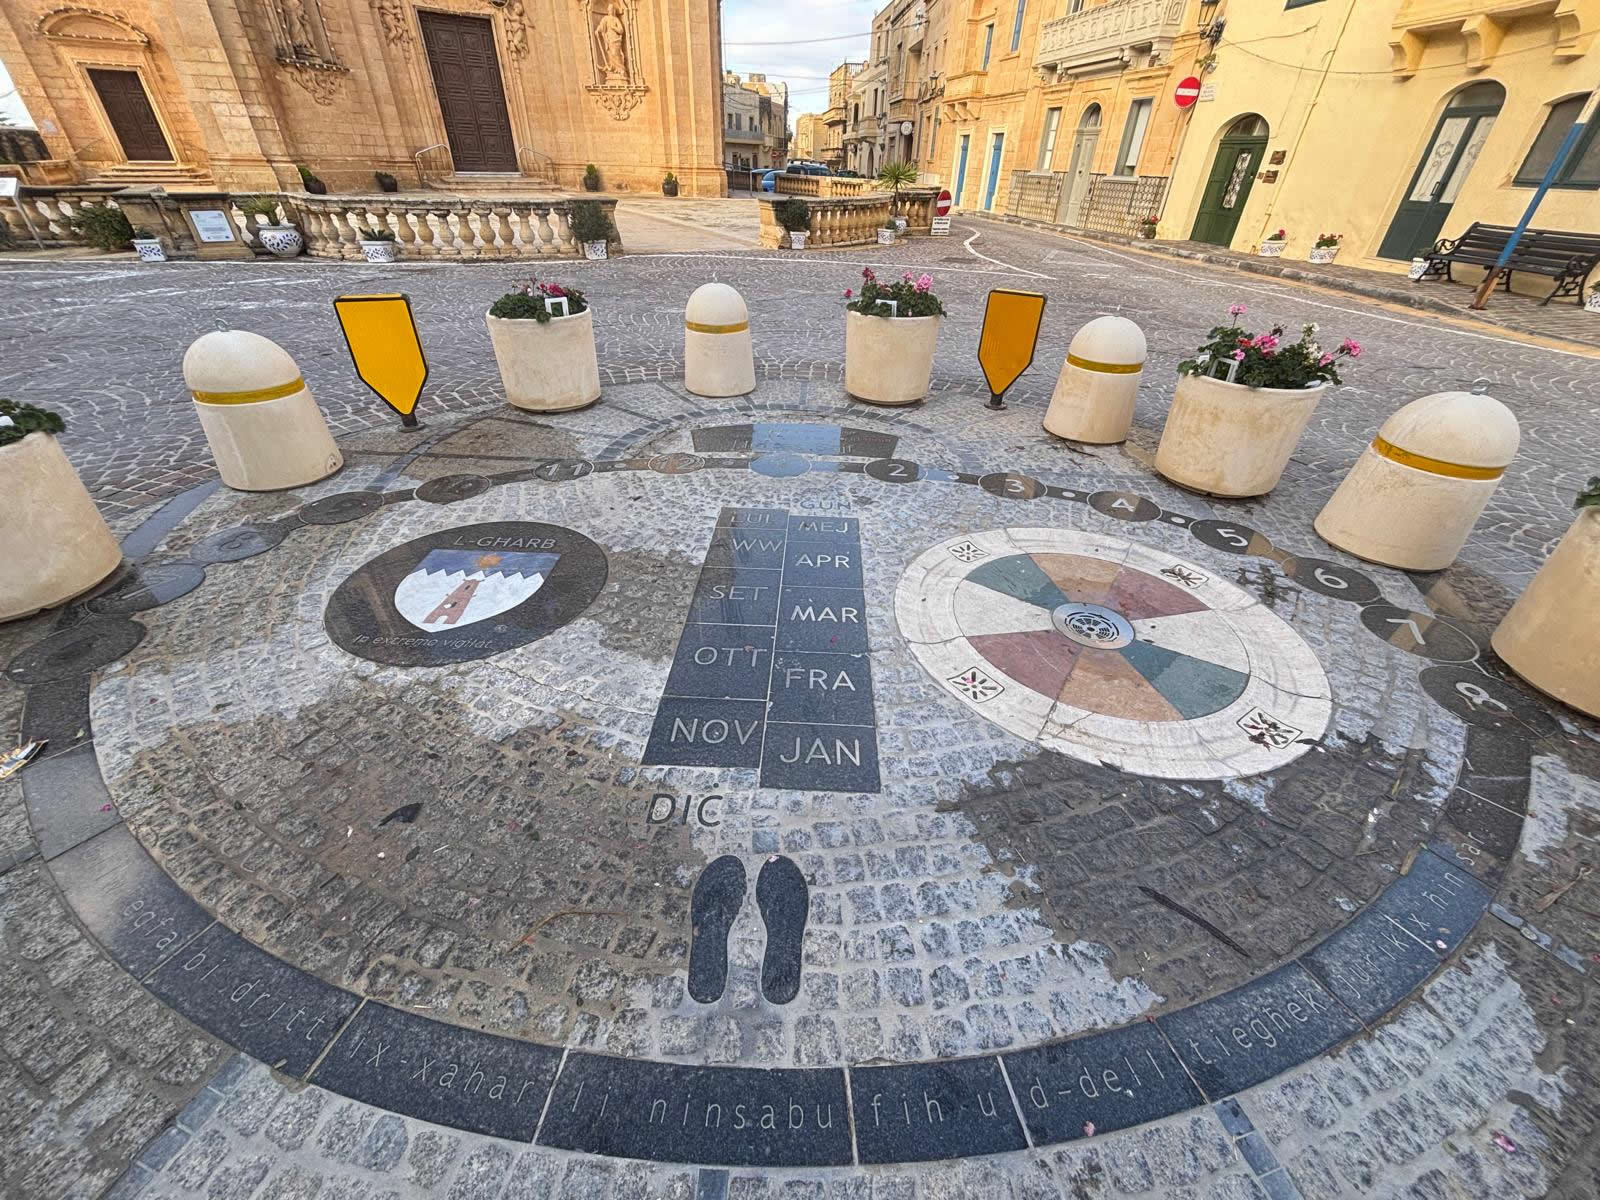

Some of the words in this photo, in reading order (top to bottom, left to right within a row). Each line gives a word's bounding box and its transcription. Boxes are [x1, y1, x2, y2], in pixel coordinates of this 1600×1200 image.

[545, 463, 588, 477] 11
[889, 465, 909, 477] 2
[1008, 479, 1025, 493] 3
[1111, 498, 1137, 512] 4
[799, 521, 849, 533] MEJ
[1216, 528, 1249, 548] 5
[795, 553, 850, 569] APR
[1314, 567, 1349, 589] 6
[710, 585, 769, 601] SET
[791, 605, 859, 623] MAR
[372, 635, 438, 646] extremo
[1385, 618, 1426, 645] 7
[694, 646, 768, 667] OTT
[785, 669, 856, 691] FRA
[670, 718, 758, 746] NOV
[780, 737, 861, 767] JAN
[183, 945, 227, 982] bi
[230, 978, 326, 1041] dritt
[350, 1030, 534, 1105] ix-xahar
[572, 1081, 613, 1118] li
[649, 1093, 833, 1130] ninsabu
[871, 1091, 944, 1127] fih
[977, 1092, 1000, 1118] u
[1029, 1050, 1165, 1109] d-dell
[1455, 831, 1485, 867] sar
